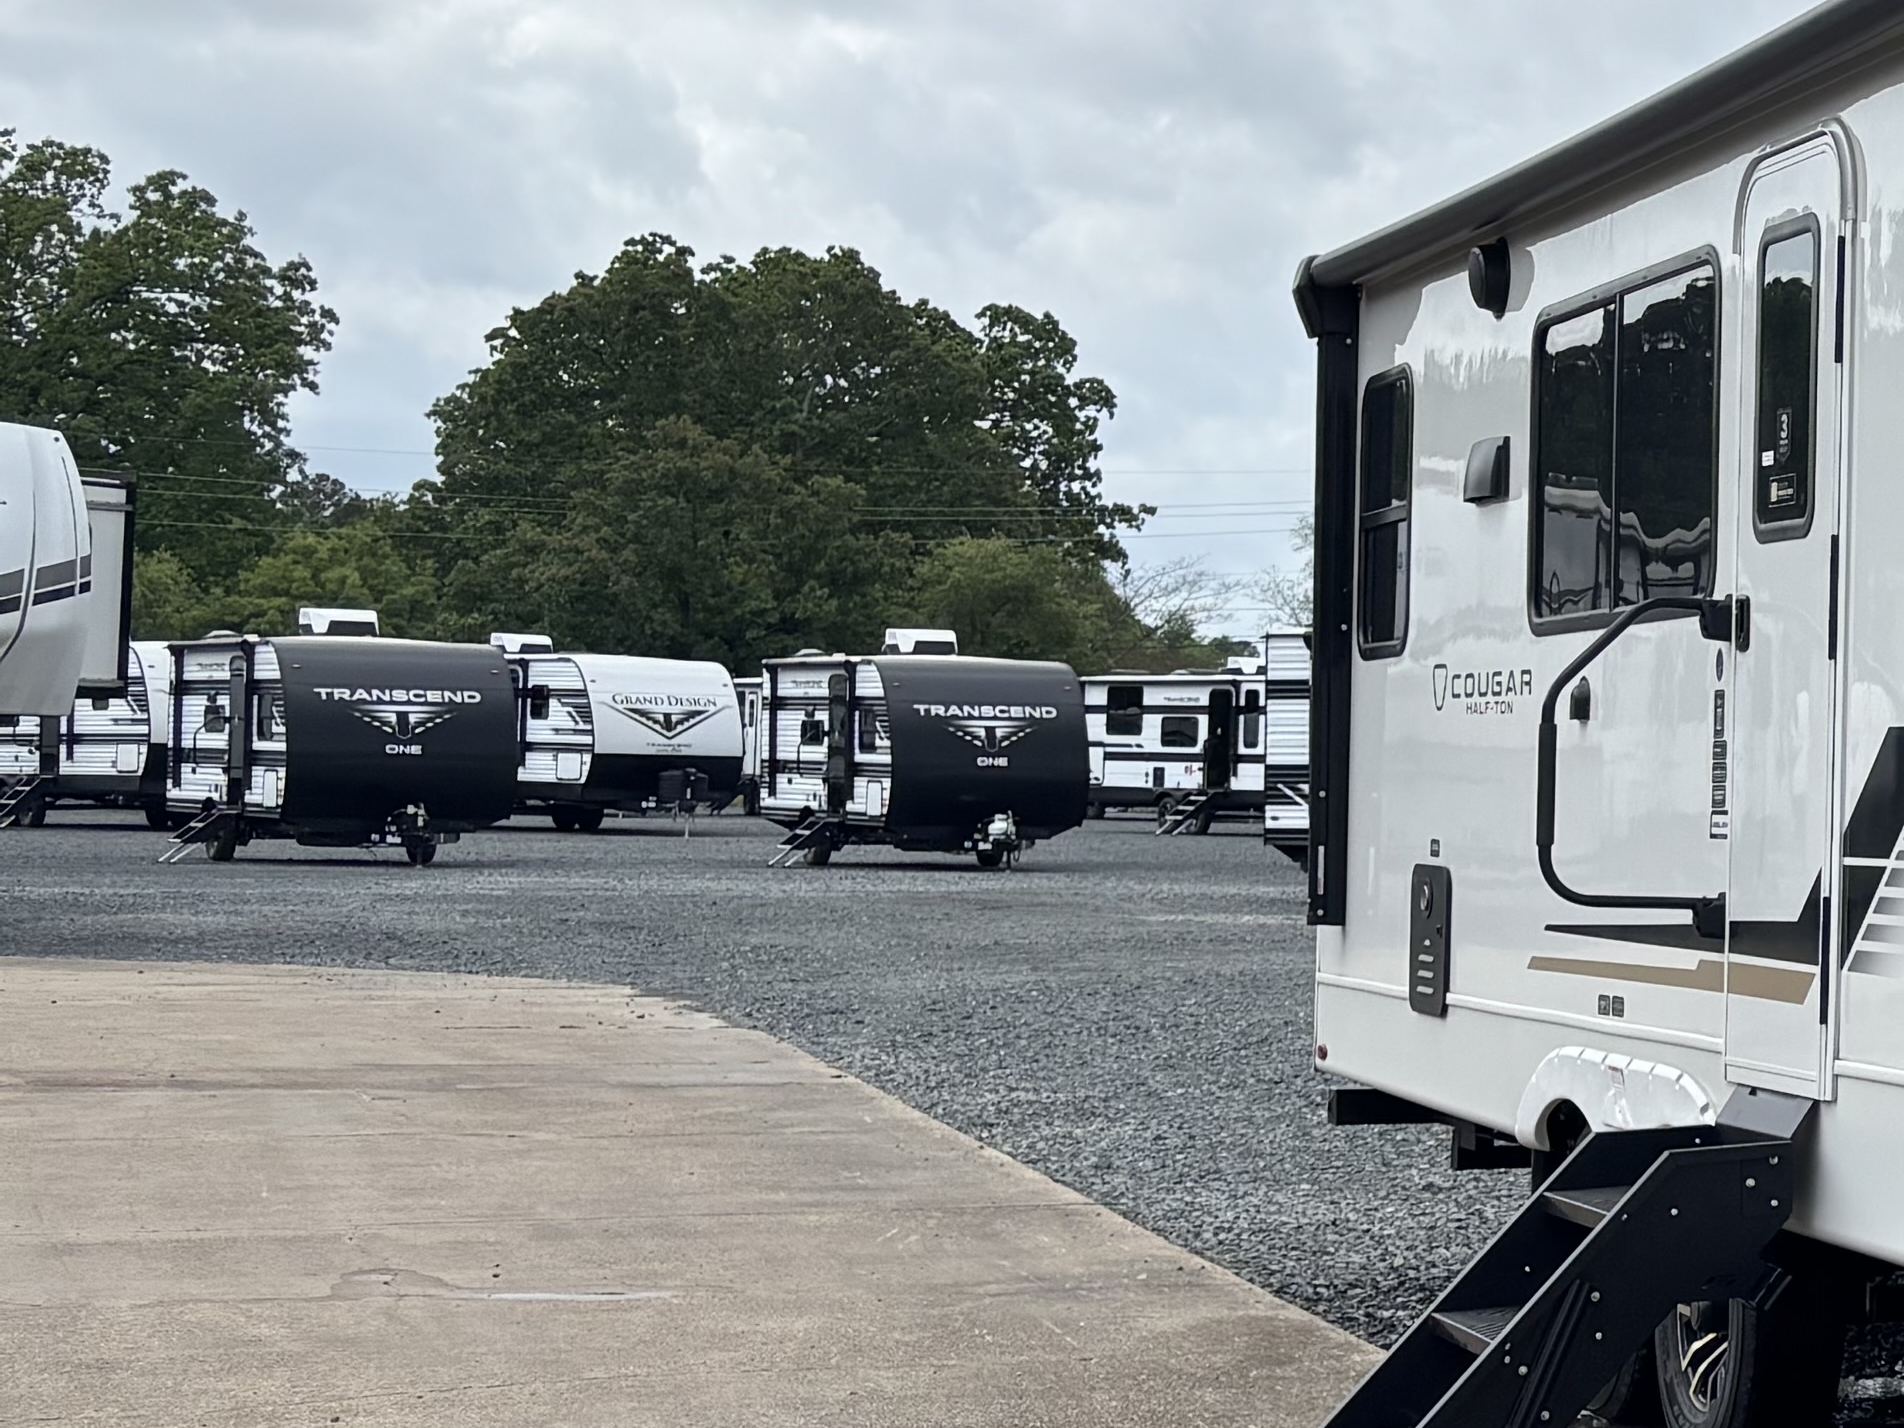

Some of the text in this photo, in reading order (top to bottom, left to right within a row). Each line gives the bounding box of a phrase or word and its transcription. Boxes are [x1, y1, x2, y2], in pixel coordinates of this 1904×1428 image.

[1451, 669, 1532, 699] COUGAR
[313, 687, 482, 704] TRANSCEND
[611, 692, 718, 708] GRAND DESIGN
[913, 704, 1058, 719] TRANSCEND
[1465, 700, 1514, 714] HALF-TON
[385, 744, 423, 755] ONE
[976, 756, 1009, 768] ONE
